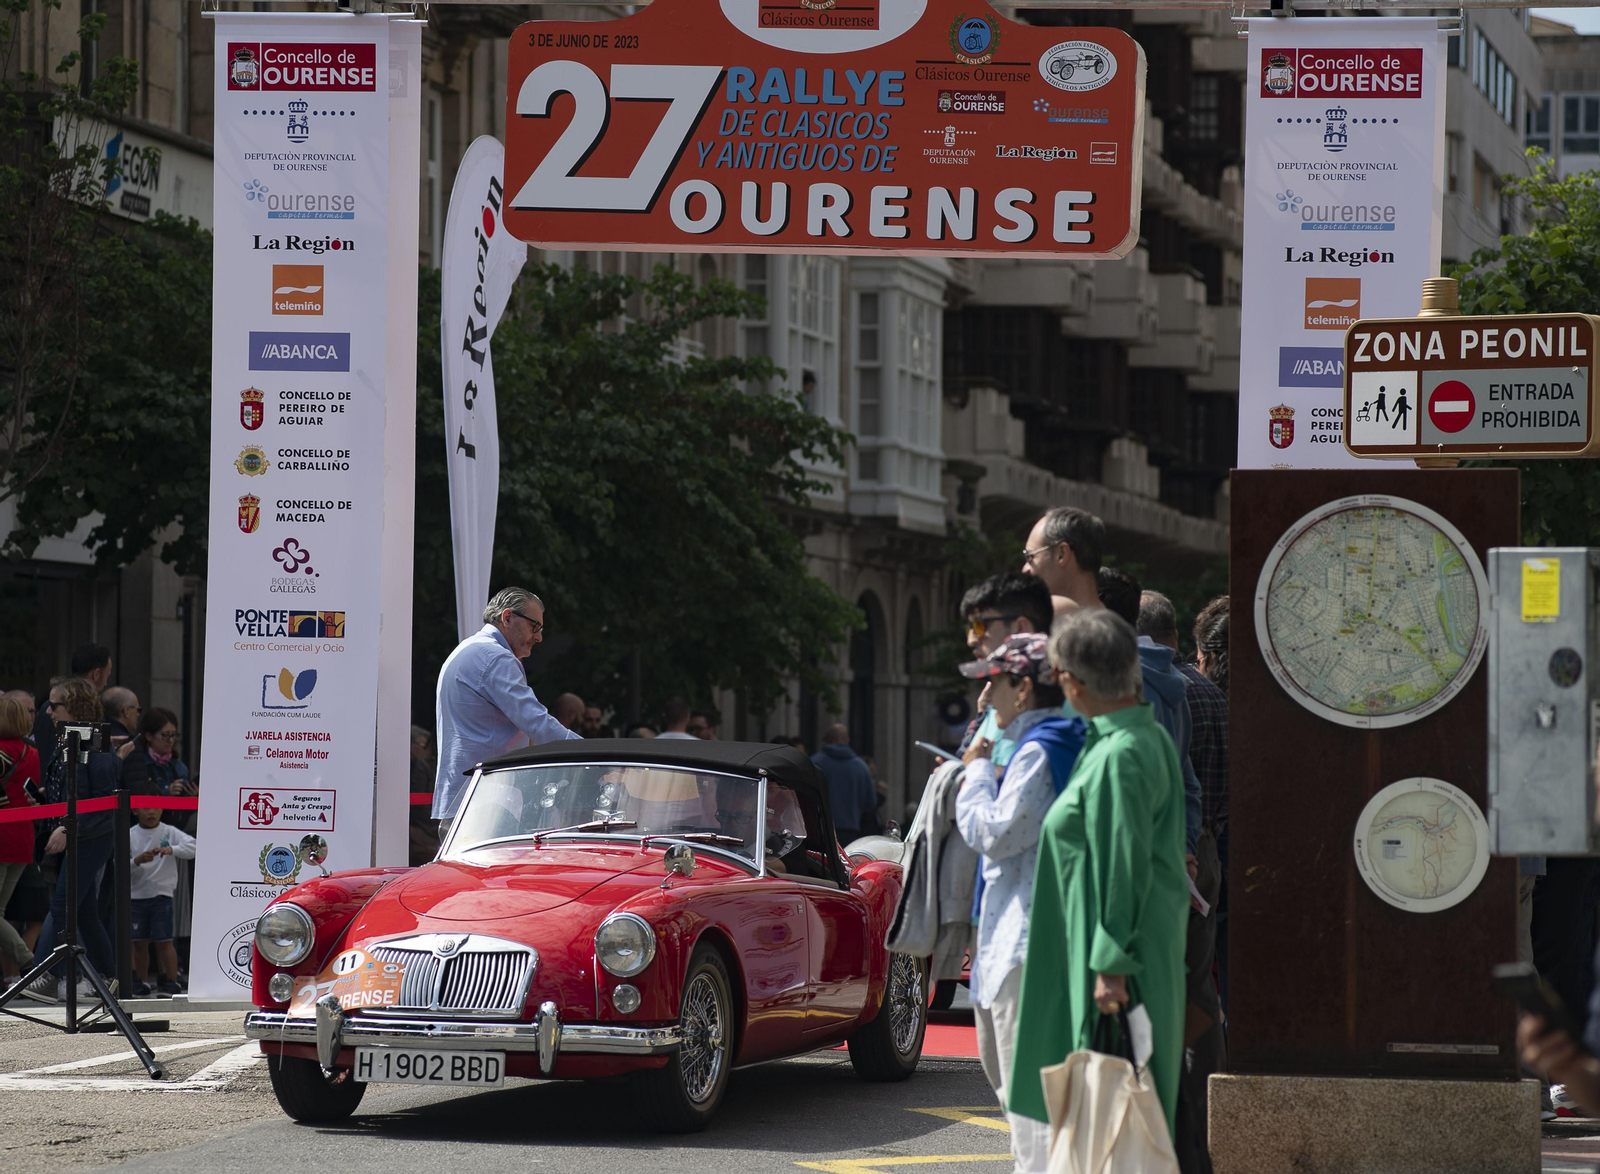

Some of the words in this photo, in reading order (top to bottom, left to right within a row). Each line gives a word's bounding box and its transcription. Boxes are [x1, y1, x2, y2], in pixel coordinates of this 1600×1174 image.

[761, 12, 815, 26] Clásicos
[818, 13, 875, 27] Ourense
[528, 33, 535, 47] 3
[538, 33, 553, 47] DE
[556, 34, 591, 48] JUNIO
[593, 34, 609, 48] DE
[613, 35, 639, 49] 2023
[263, 48, 332, 64] Concello
[337, 49, 356, 64] de
[1300, 54, 1375, 70] Concello
[1380, 54, 1400, 70] de
[263, 67, 374, 86] OURENSE
[915, 66, 970, 81] Clásicos
[973, 68, 1031, 83] Ourense
[726, 66, 906, 107] RALLYE
[1299, 73, 1420, 92] OURENSE
[954, 92, 986, 101] Concello
[987, 93, 997, 101] de
[953, 101, 1005, 112] OURENSE
[1048, 107, 1109, 119] ourense
[718, 108, 758, 137] DE
[760, 109, 892, 140] CLASICOS
[508, 59, 725, 212] 27
[302, 153, 356, 161] PROVINCIAL
[697, 141, 715, 169] Y
[715, 141, 857, 172] ANTIGUOS
[859, 144, 900, 173] DE
[923, 148, 976, 157] DEPUTACIÓN
[996, 145, 1020, 158] La
[1021, 145, 1078, 162] Región
[273, 163, 285, 171] DE
[286, 163, 328, 171] OURENSE
[929, 157, 968, 165] OURENSE
[1340, 162, 1399, 171] PROVINCIAL
[1308, 173, 1321, 181] DE
[1322, 173, 1367, 181] OURENSE
[267, 194, 355, 211] ourense
[669, 179, 1097, 244] OURENSE
[1301, 204, 1396, 223] ourense
[1312, 223, 1348, 231] capital
[1351, 223, 1384, 231] termal
[252, 234, 281, 250] La
[284, 234, 355, 255] Región
[1284, 247, 1315, 263] La
[1319, 247, 1395, 268] Región
[274, 300, 322, 311] telemiño
[1353, 330, 1446, 363] ZONA
[1460, 326, 1587, 359] PEONIL
[279, 391, 335, 400] CONCELLO
[338, 391, 352, 401] DE
[1488, 382, 1575, 401] ENTRADA
[279, 403, 326, 413] PEREIRO
[330, 404, 345, 414] DE
[278, 416, 324, 426] AGUIAR
[1481, 410, 1581, 429] PROHIBIDA
[1310, 434, 1344, 444] AGUI
[277, 448, 333, 458] CONCELLO
[336, 449, 351, 459] DE
[277, 460, 350, 471] CARBALLIÑO
[276, 499, 334, 510] CONCELLO
[337, 500, 352, 510] DE
[275, 512, 326, 523] MACEDA
[271, 577, 315, 586] BODEGAS
[269, 585, 317, 594] GALLEGAS
[235, 609, 288, 623] PONTE
[235, 623, 287, 637] VELLA
[233, 641, 265, 651] Centro
[267, 642, 313, 652] Comercial
[314, 645, 321, 654] y
[322, 643, 345, 653] Ocio
[245, 731, 283, 741] J.VARELA
[284, 731, 332, 742] ASISTENCIA
[266, 747, 304, 759] Celanova
[305, 748, 330, 760] Motor
[279, 761, 309, 770] Asistencia
[293, 795, 321, 803] Seguros
[307, 803, 332, 811] Crespo
[283, 813, 317, 821] helvetia
[230, 886, 277, 898] Clásicos
[340, 954, 357, 972] 11
[358, 1052, 373, 1077] H
[383, 1053, 444, 1081] 1902
[450, 1055, 500, 1083] BBD
